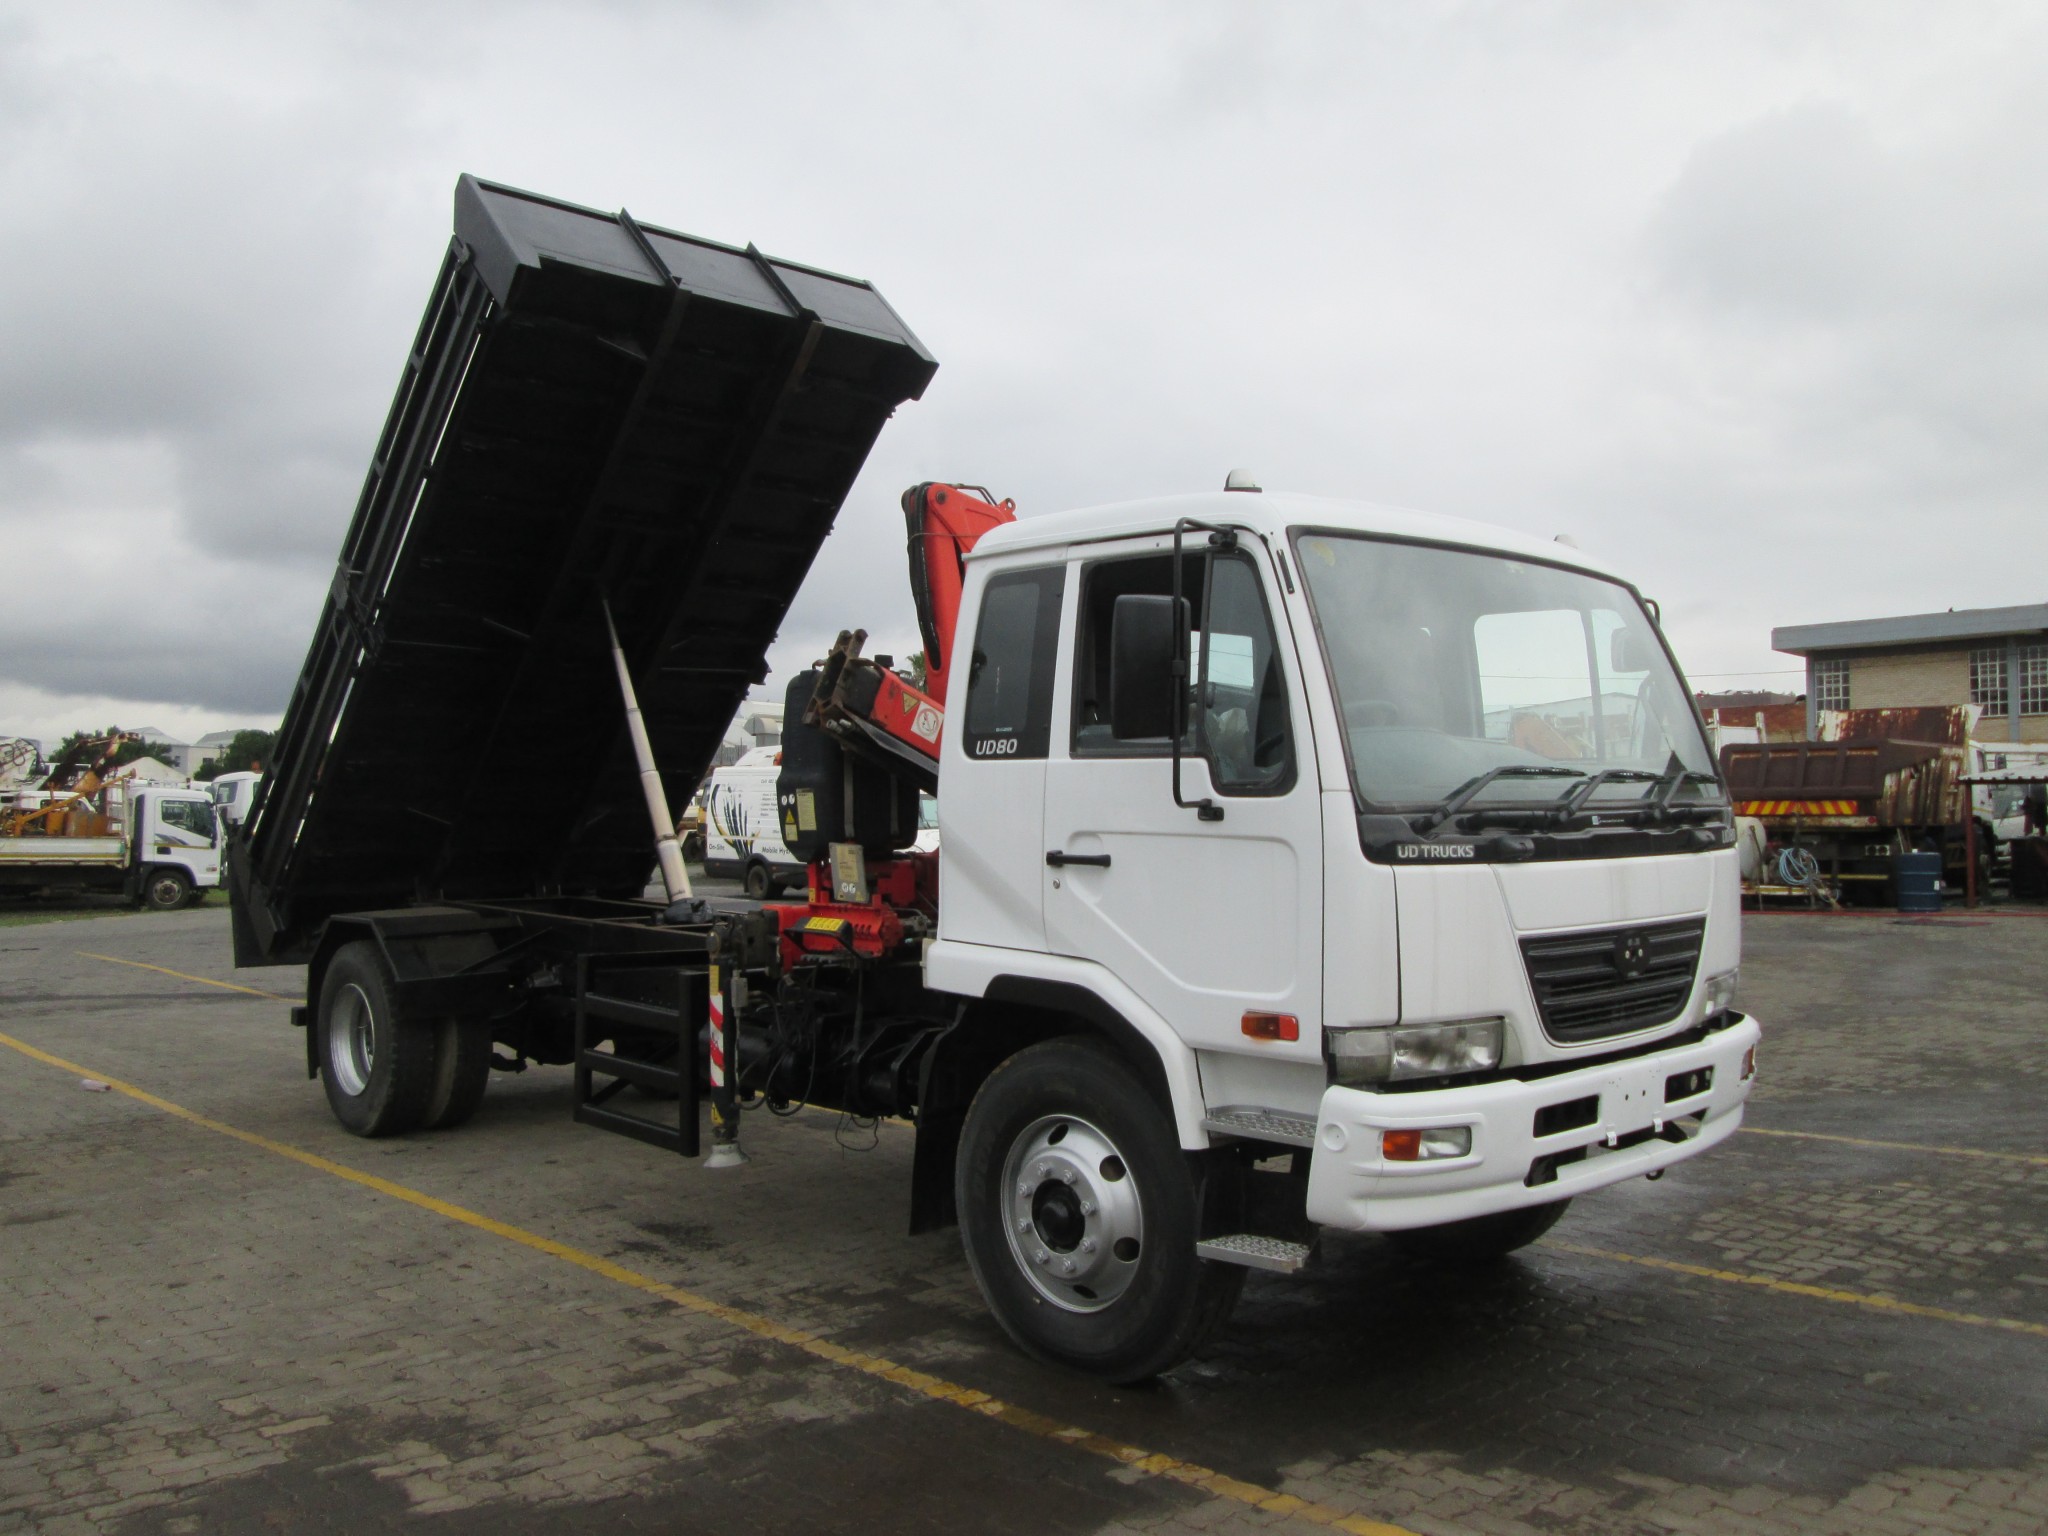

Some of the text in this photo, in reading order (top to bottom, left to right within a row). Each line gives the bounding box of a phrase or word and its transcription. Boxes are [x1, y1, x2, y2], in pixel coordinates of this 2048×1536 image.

[976, 739, 1017, 755] UD80
[1398, 844, 1474, 858] UD TRUCKS
